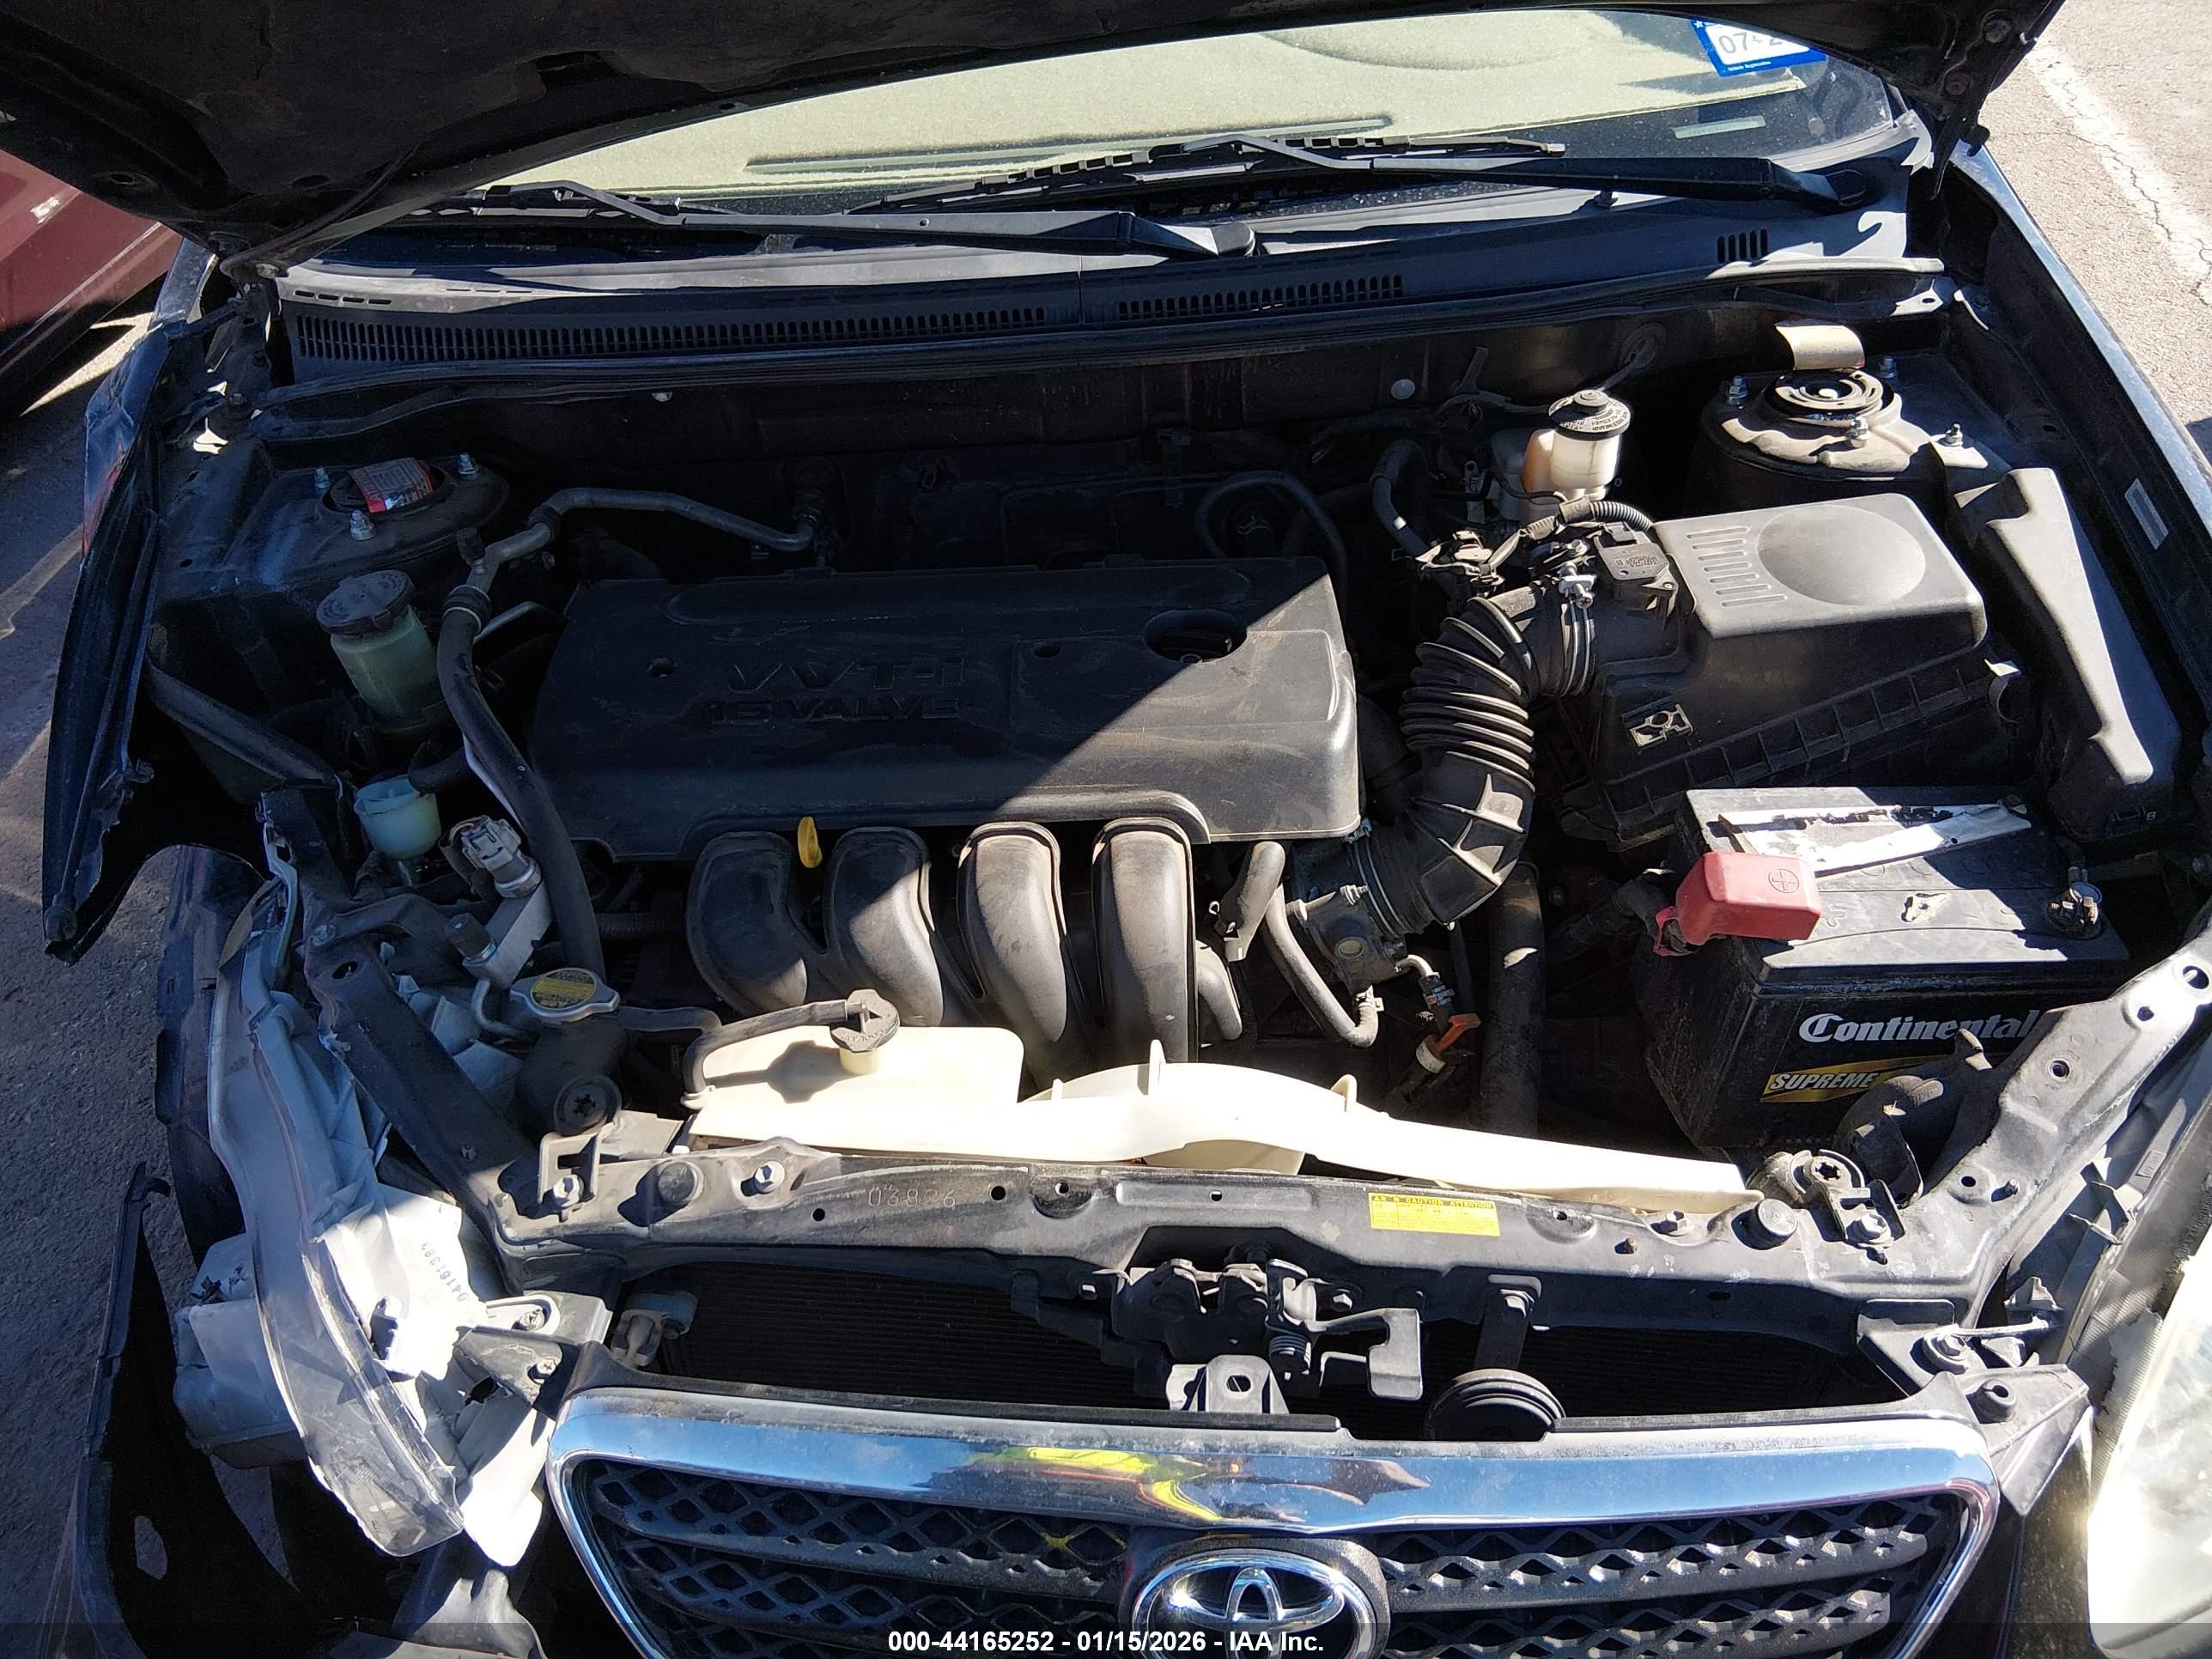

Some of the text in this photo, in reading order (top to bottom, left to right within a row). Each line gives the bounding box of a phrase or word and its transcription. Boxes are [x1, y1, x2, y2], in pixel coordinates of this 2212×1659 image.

[1719, 32, 1748, 53] 07
[1799, 1010, 2040, 1042] Continental
[1771, 1073, 1879, 1090] SUPREME
